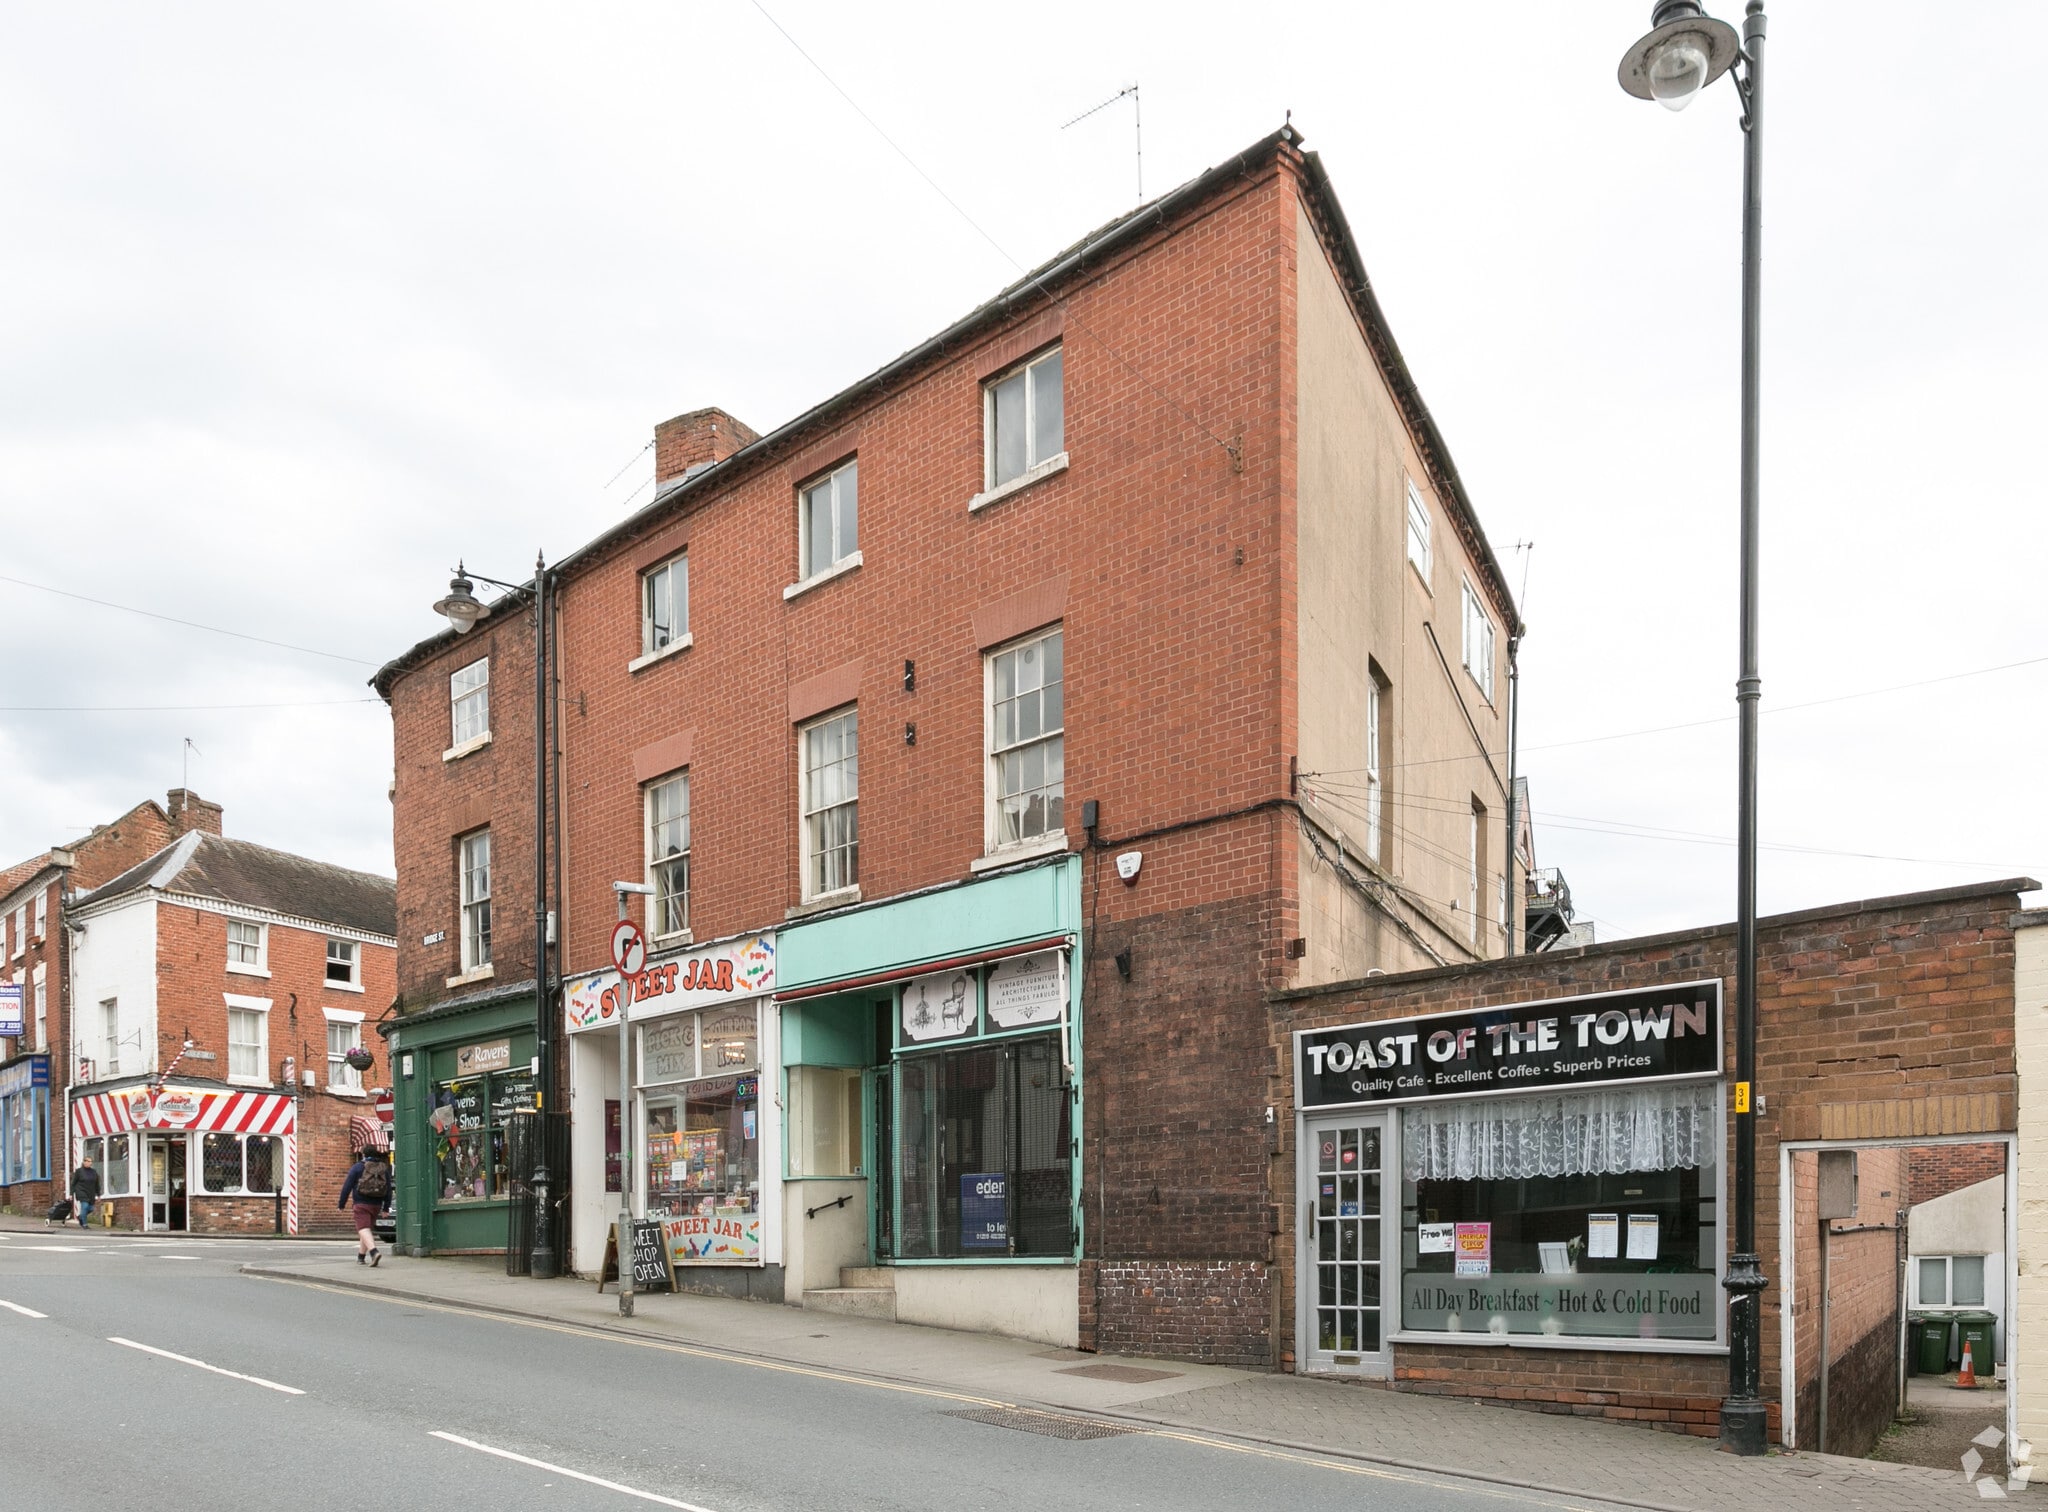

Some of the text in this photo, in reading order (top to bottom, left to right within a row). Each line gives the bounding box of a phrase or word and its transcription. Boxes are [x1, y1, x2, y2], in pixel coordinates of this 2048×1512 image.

[683, 959, 734, 992] JAR
[999, 980, 1024, 989] VINTAGE
[1002, 983, 1048, 997] ARCHITECTURAL
[1008, 994, 1030, 1004] THINGS
[646, 1026, 682, 1054] PICK
[1308, 1001, 1707, 1075] TOAST OF THE TOWN
[474, 1044, 509, 1062] Ravens
[656, 1051, 686, 1076] MIX
[1351, 1078, 1394, 1093] Quality
[1396, 1074, 1424, 1088] Cafe
[1435, 1068, 1493, 1085] Excellent
[1498, 1064, 1541, 1079] Coffee
[1553, 1057, 1603, 1076] Superb
[1607, 1054, 1652, 1069] Prices
[456, 1096, 476, 1108] vens
[460, 1114, 480, 1130] Shop
[713, 1218, 743, 1240] JAR
[1420, 1229, 1441, 1239] Free
[1461, 1240, 1485, 1250] CIRCUS
[634, 1261, 666, 1282] OPEN
[1411, 1288, 1431, 1310] All
[1436, 1288, 1464, 1316] Day
[1469, 1288, 1540, 1312] Breakfast
[1558, 1289, 1588, 1313] Hot
[1592, 1288, 1607, 1313] &
[1612, 1289, 1652, 1314] Cold
[1657, 1289, 1701, 1315] Food
